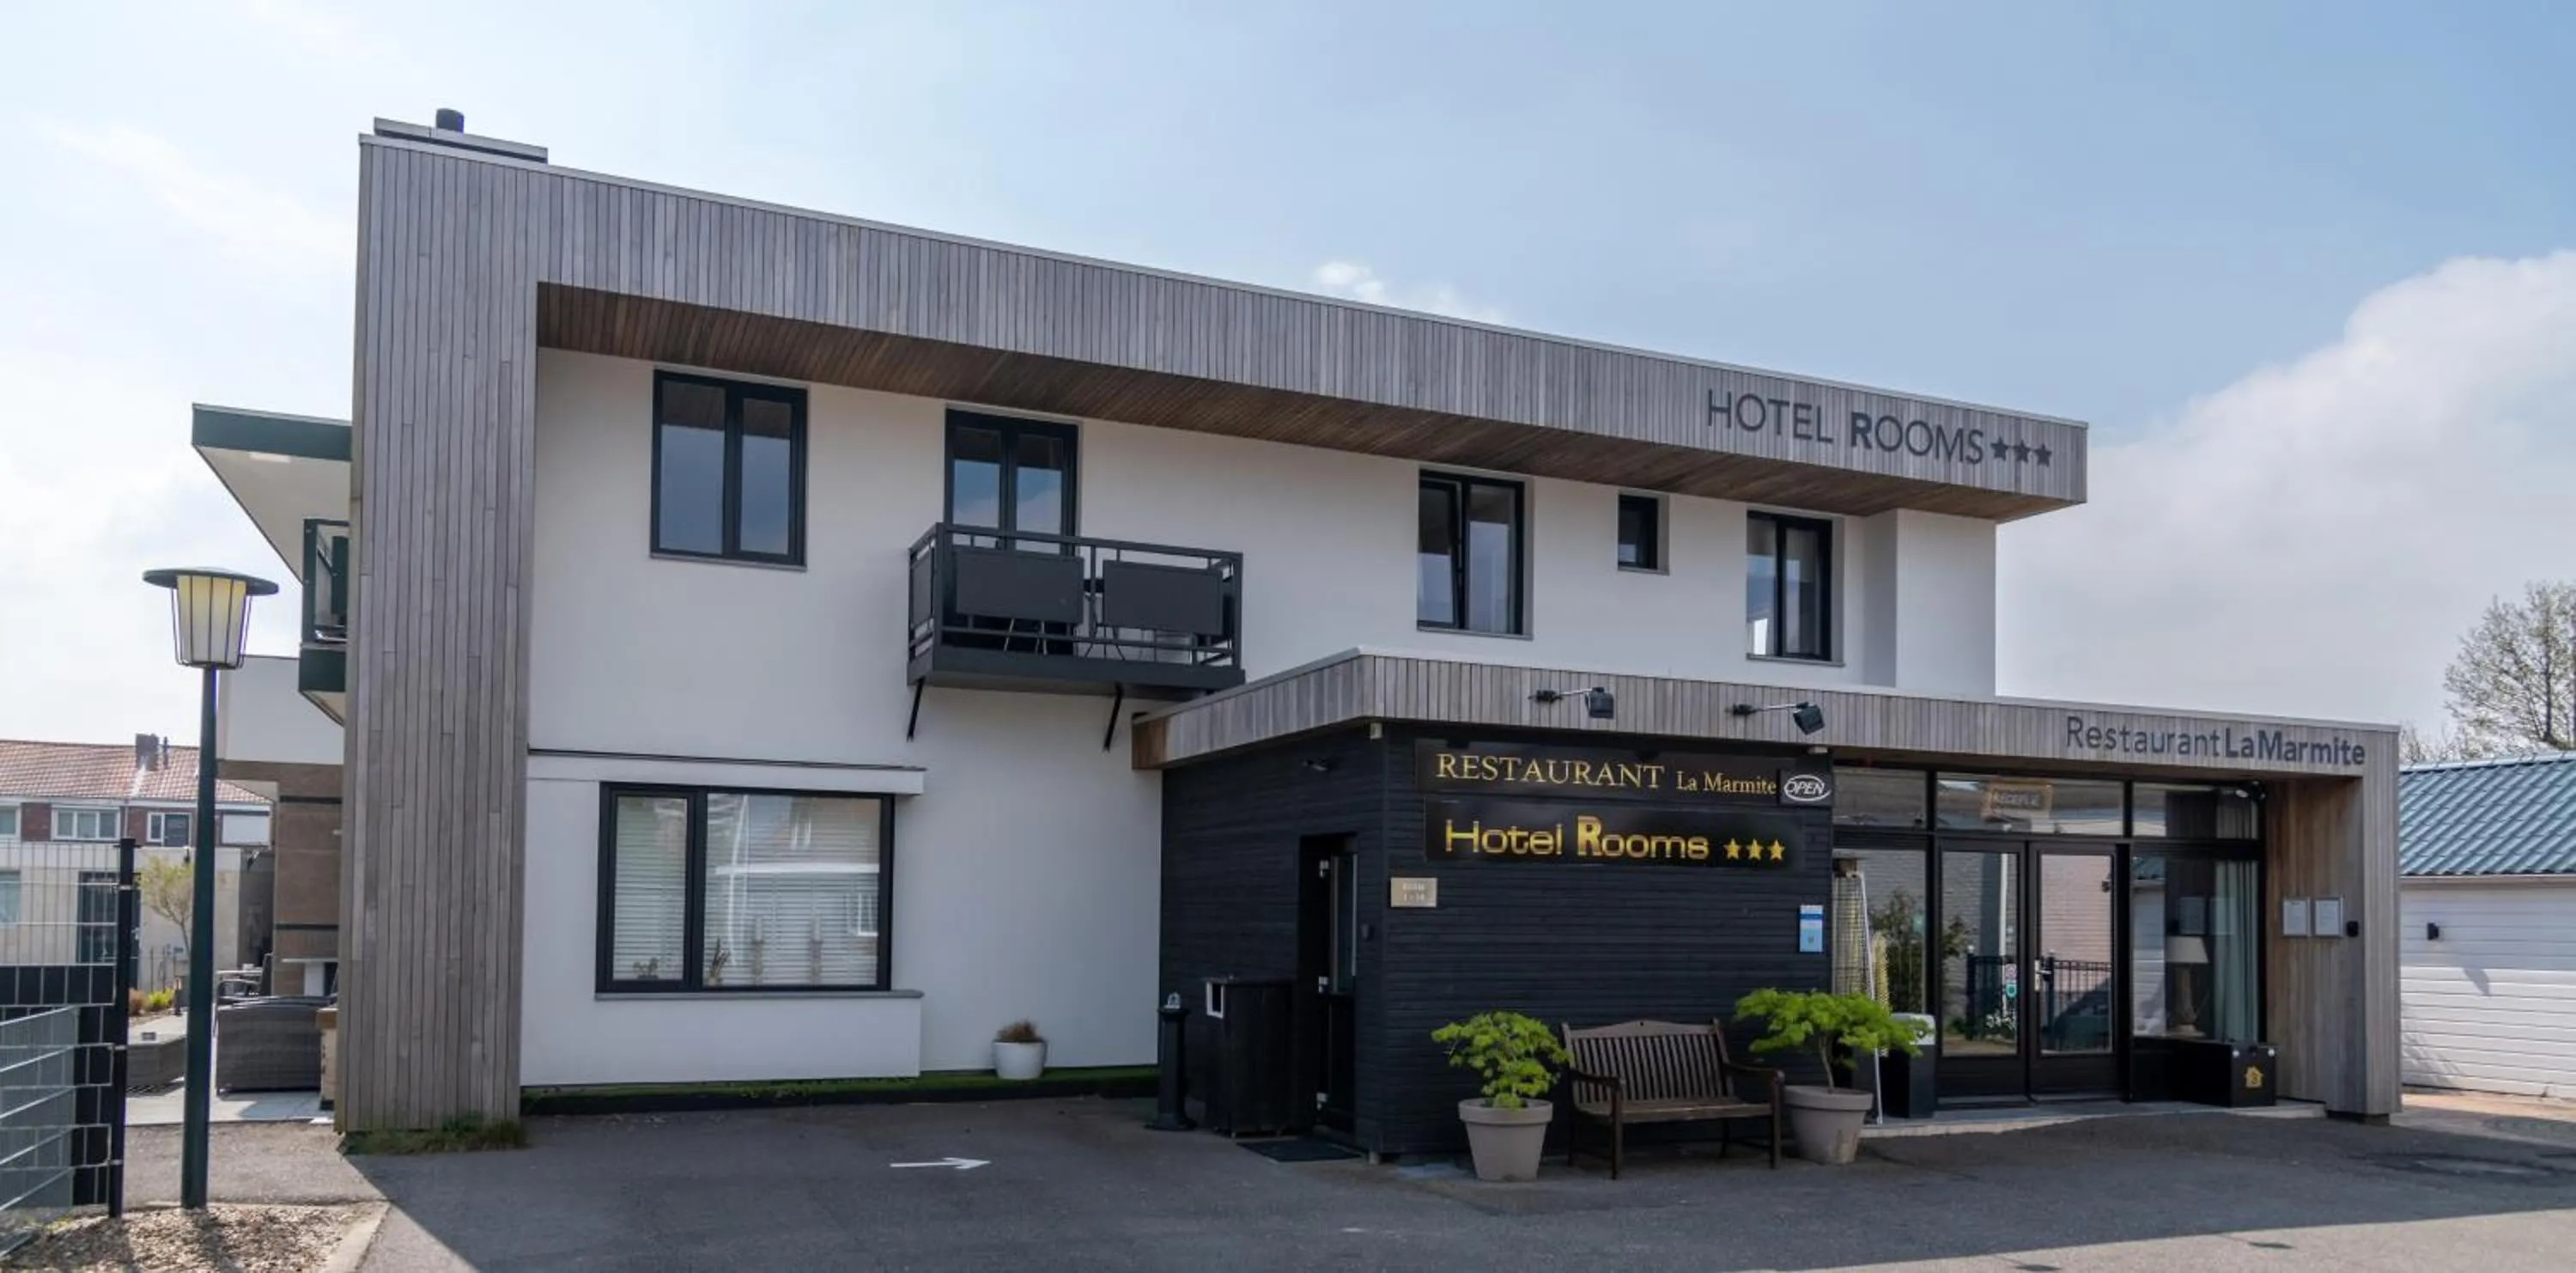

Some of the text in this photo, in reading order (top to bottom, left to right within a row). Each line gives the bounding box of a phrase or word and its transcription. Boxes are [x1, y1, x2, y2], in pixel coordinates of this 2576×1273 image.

[1707, 389, 1984, 465] HOTEL ROOMS
[2066, 716, 2221, 758] Restaurant
[1437, 753, 1777, 795] RESTAURANT La Marmite
[1784, 780, 1825, 795] OPEN
[1444, 815, 1710, 860] Hotel Rooms
